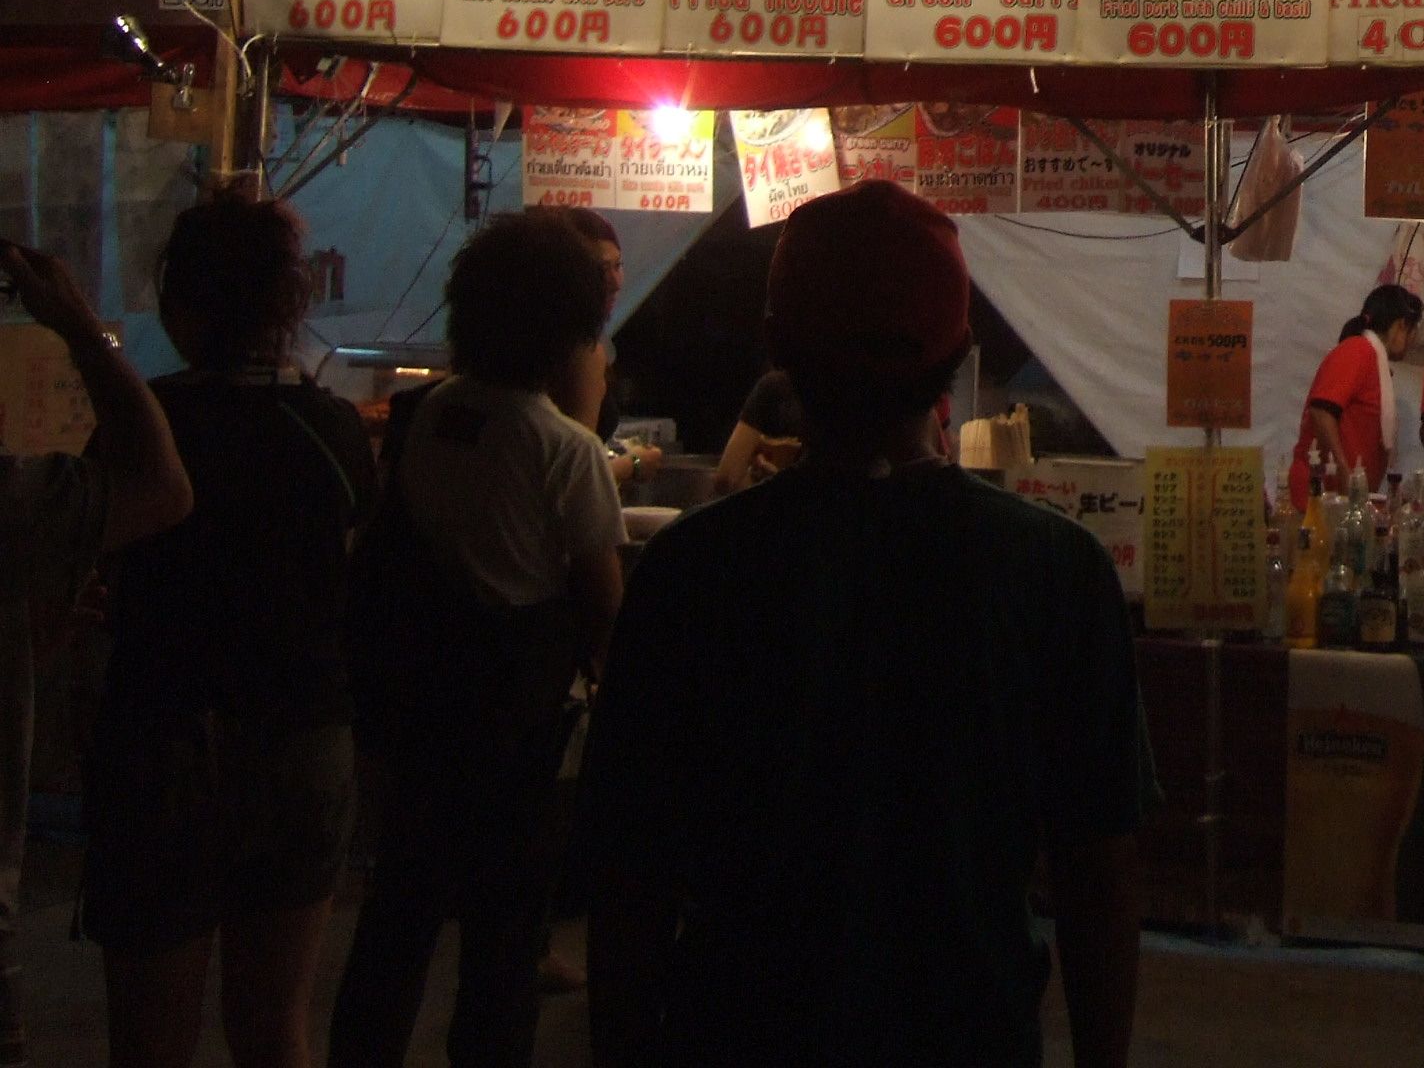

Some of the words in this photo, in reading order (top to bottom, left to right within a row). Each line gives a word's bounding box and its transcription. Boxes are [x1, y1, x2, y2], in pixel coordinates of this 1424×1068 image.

[497, 7, 611, 44] 600円
[710, 12, 829, 48] 600円
[934, 13, 1058, 51] 600円
[1127, 20, 1255, 59] 600円
